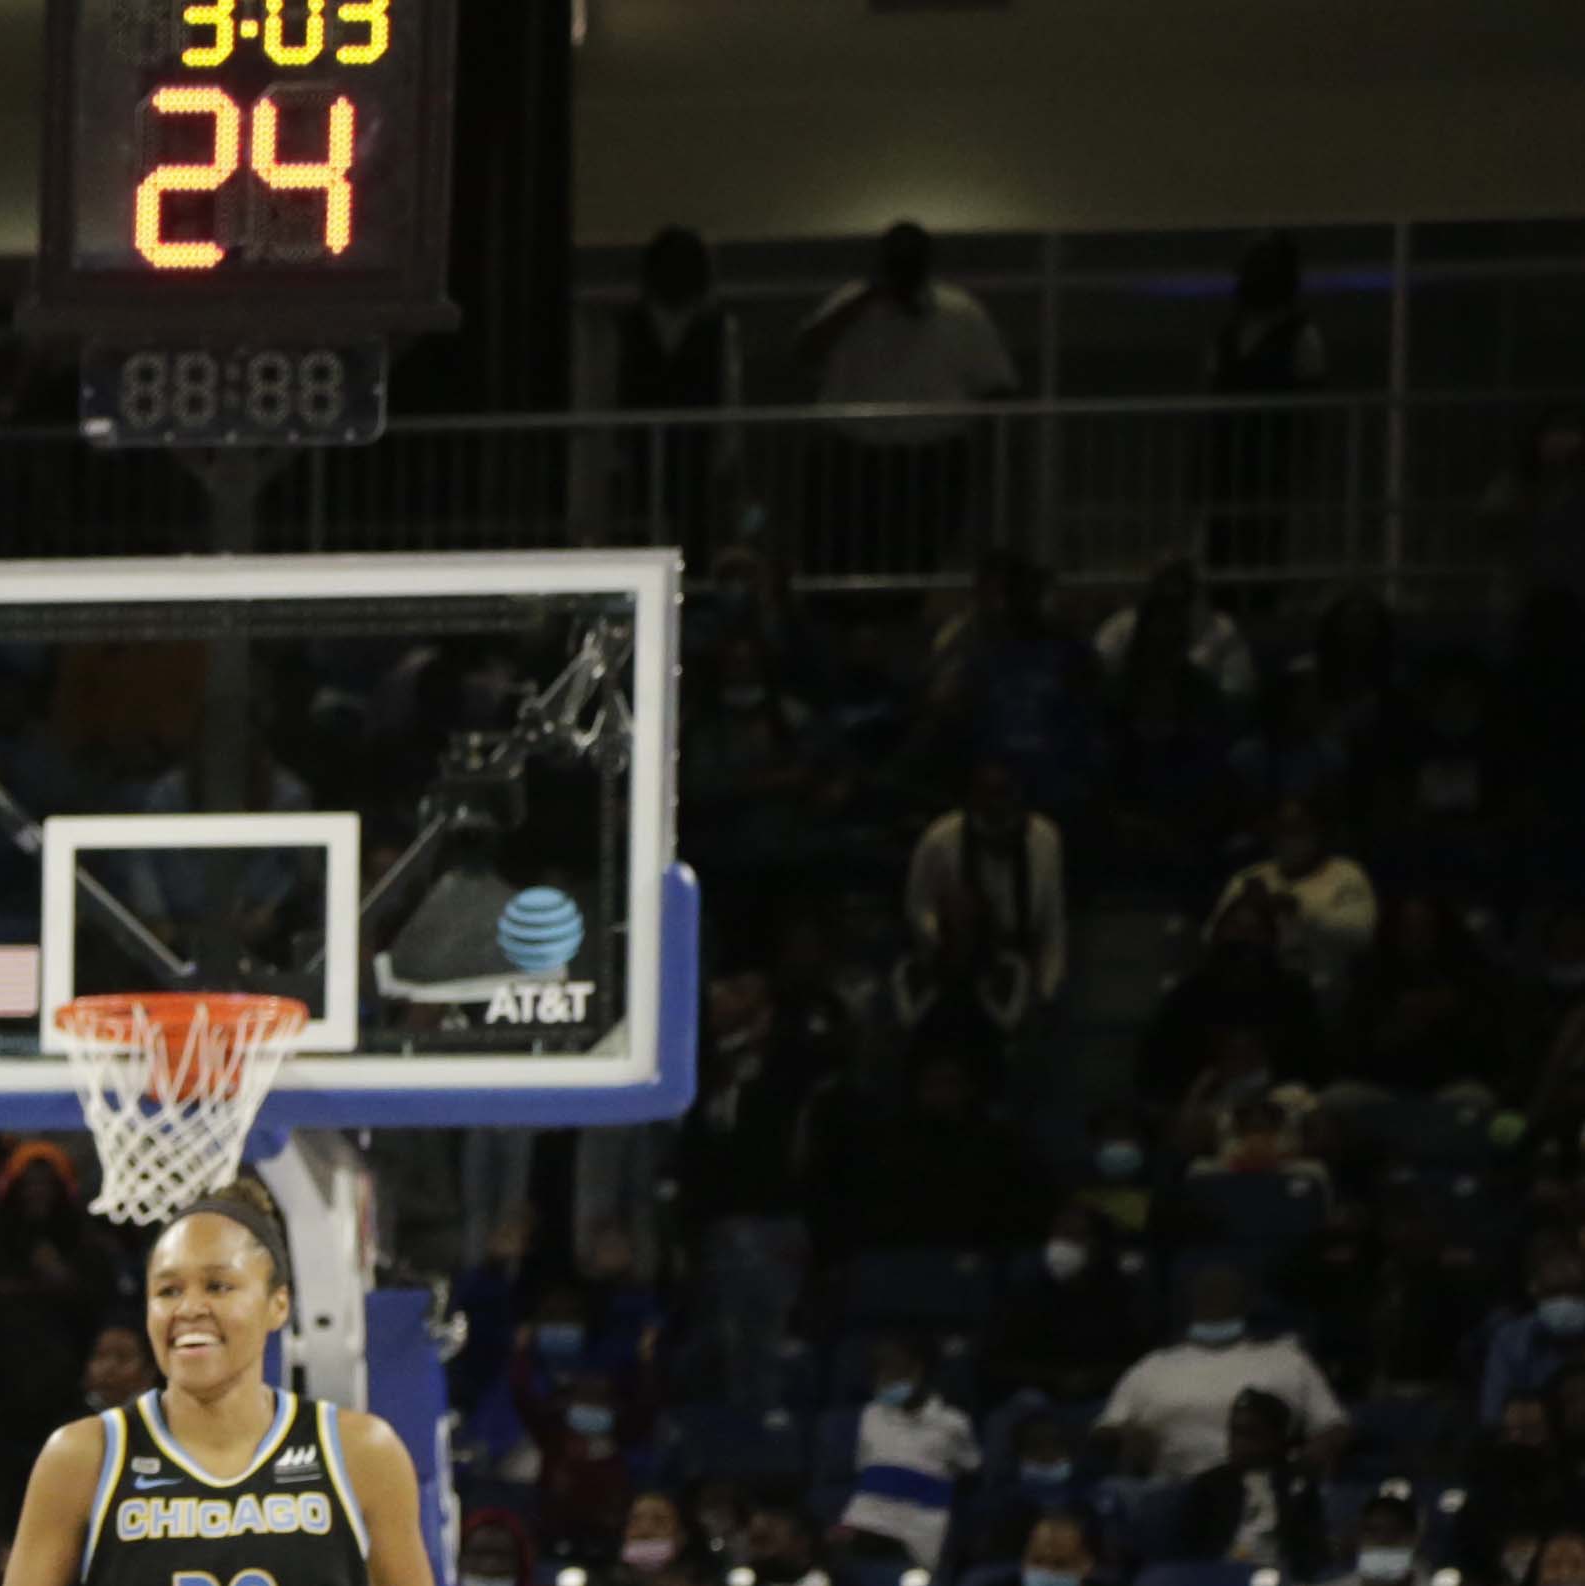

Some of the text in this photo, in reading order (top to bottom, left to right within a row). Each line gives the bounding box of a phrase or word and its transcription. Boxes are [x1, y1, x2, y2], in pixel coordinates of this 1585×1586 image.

[135, 86, 354, 268] 24
[485, 981, 595, 1024] AT&T
[116, 1491, 332, 1542] CHICAGO
